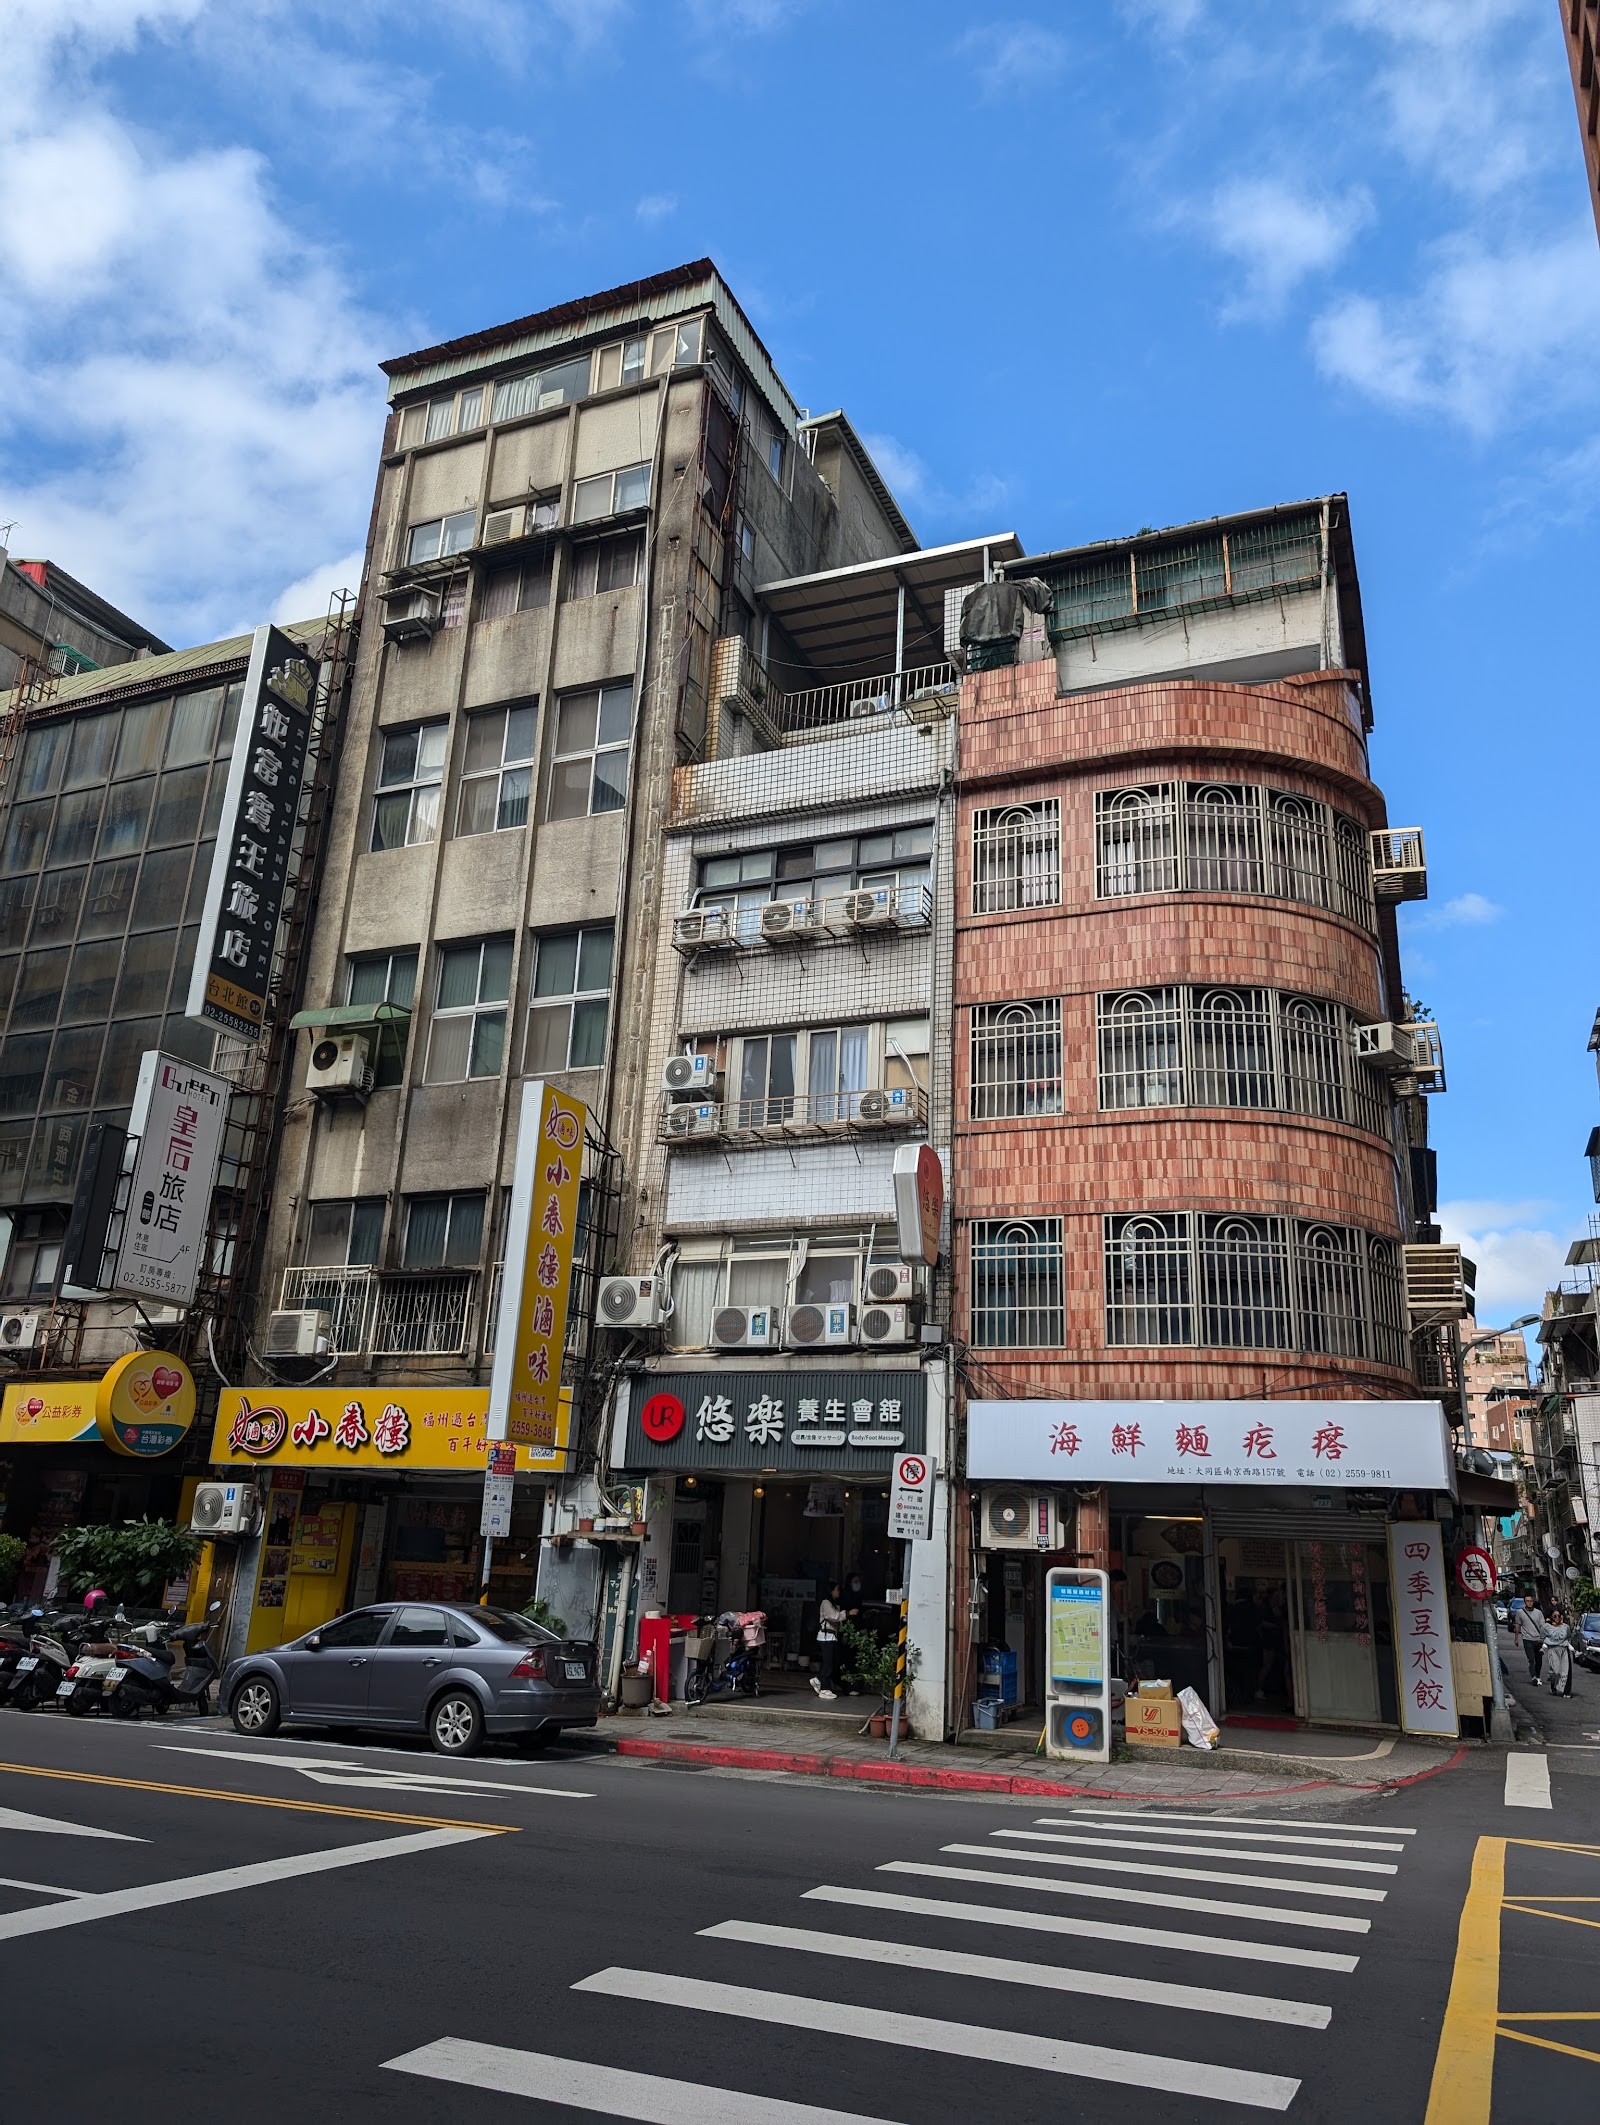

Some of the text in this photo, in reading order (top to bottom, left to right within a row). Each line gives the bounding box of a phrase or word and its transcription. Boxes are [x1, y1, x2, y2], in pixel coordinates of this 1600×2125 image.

[255, 728, 304, 980] KING PLAZA HOTEL
[208, 979, 248, 1011] 台北館
[204, 1005, 259, 1039] 02-25582255
[188, 1090, 209, 1104] HOTEL
[153, 1105, 198, 1234] 皇后旅店
[179, 1245, 190, 1254] 4F
[123, 1272, 187, 1295] 02-2555-5877
[528, 1155, 570, 1385] 小春樓滷味
[42, 1405, 82, 1418] 公益彩券
[291, 1401, 410, 1453] 小春樓
[511, 1420, 552, 1440] 2559-3648
[1048, 1421, 1348, 1461] 海鮮麵疙瘩
[1404, 1542, 1448, 1711] 四季豆水餃
[1135, 1726, 1169, 1737] YS-520
